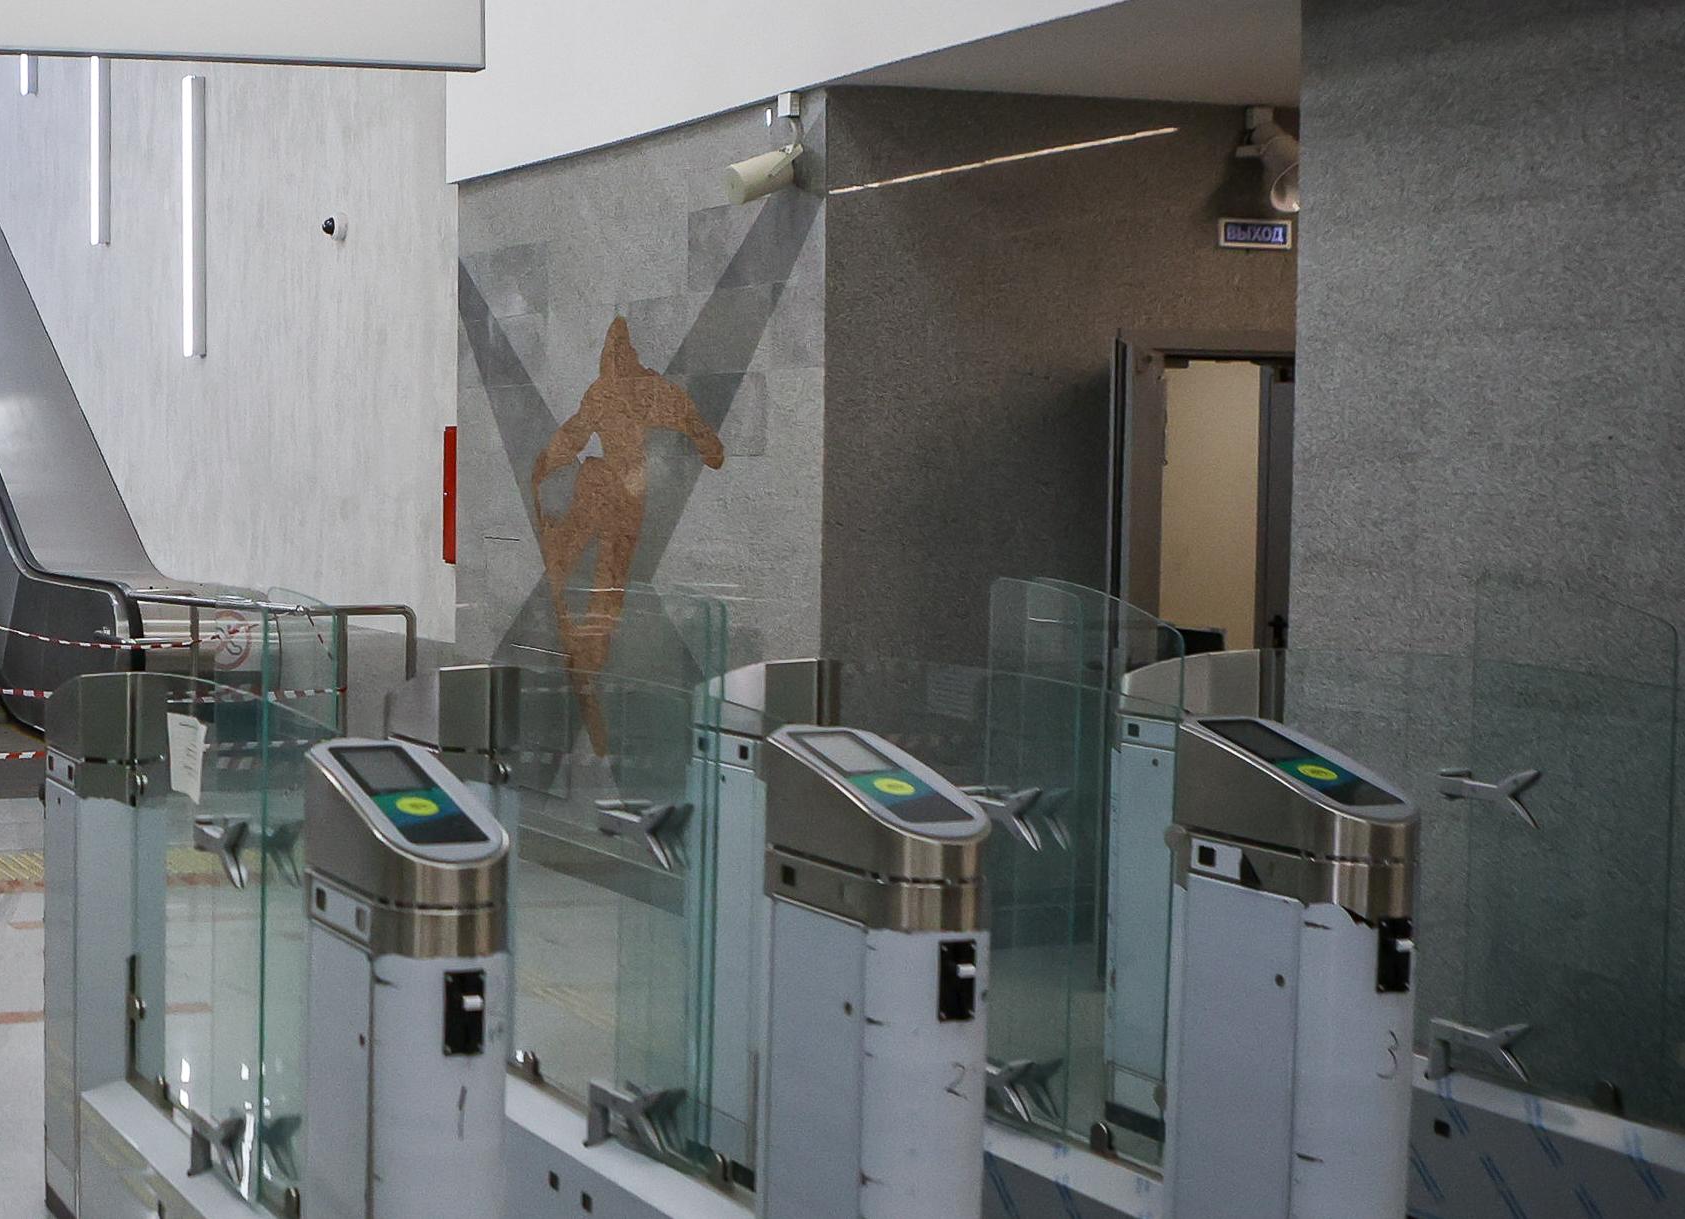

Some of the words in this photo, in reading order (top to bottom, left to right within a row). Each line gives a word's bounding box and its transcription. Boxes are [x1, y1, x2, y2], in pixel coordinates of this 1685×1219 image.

[1227, 224, 1284, 243] ВЫХОД
[1375, 1029, 1400, 1079] 3
[945, 1062, 968, 1100] 2
